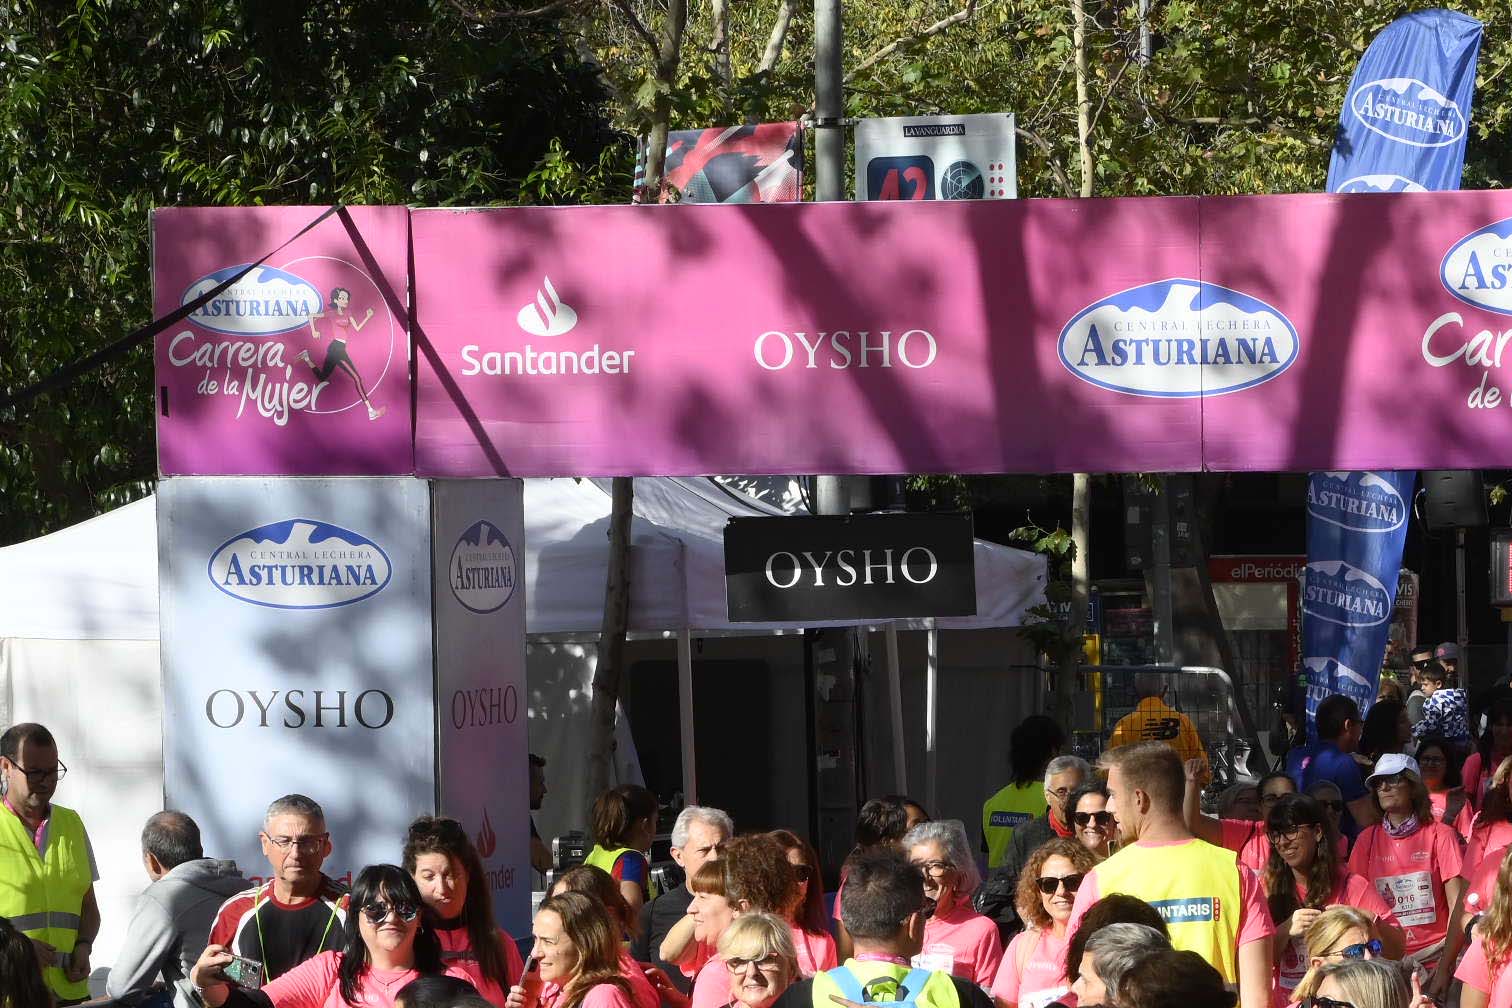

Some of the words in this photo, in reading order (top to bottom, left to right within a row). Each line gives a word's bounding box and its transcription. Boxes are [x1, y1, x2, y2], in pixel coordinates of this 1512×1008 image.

[914, 124, 965, 136] VANGUARDIA
[1359, 92, 1456, 138] ASTURIANA
[1113, 319, 1188, 332] CENTRAL
[1196, 318, 1272, 331] LECHERA
[168, 330, 286, 369] Carrera
[461, 344, 635, 377] Santander
[753, 329, 938, 370] OYSHO
[1076, 323, 1281, 367] ASTURIANA
[197, 371, 219, 395] de
[223, 367, 240, 396] la
[236, 364, 330, 426] Mujer
[1467, 371, 1502, 410] de
[1307, 480, 1399, 525] ASTURIANA
[222, 552, 379, 587] ASTURIANA
[250, 550, 308, 560] CENTRAL
[314, 550, 373, 560] LECHERA
[454, 554, 513, 591] ASTURIANA
[765, 546, 939, 590] OYSHO
[1231, 562, 1306, 581] elPeriódi
[1303, 585, 1384, 618] STURIANA
[205, 688, 395, 729] OYSHO
[451, 685, 518, 730] OYSHO
[488, 865, 516, 889] nder
[1156, 903, 1211, 920] NTARIS
